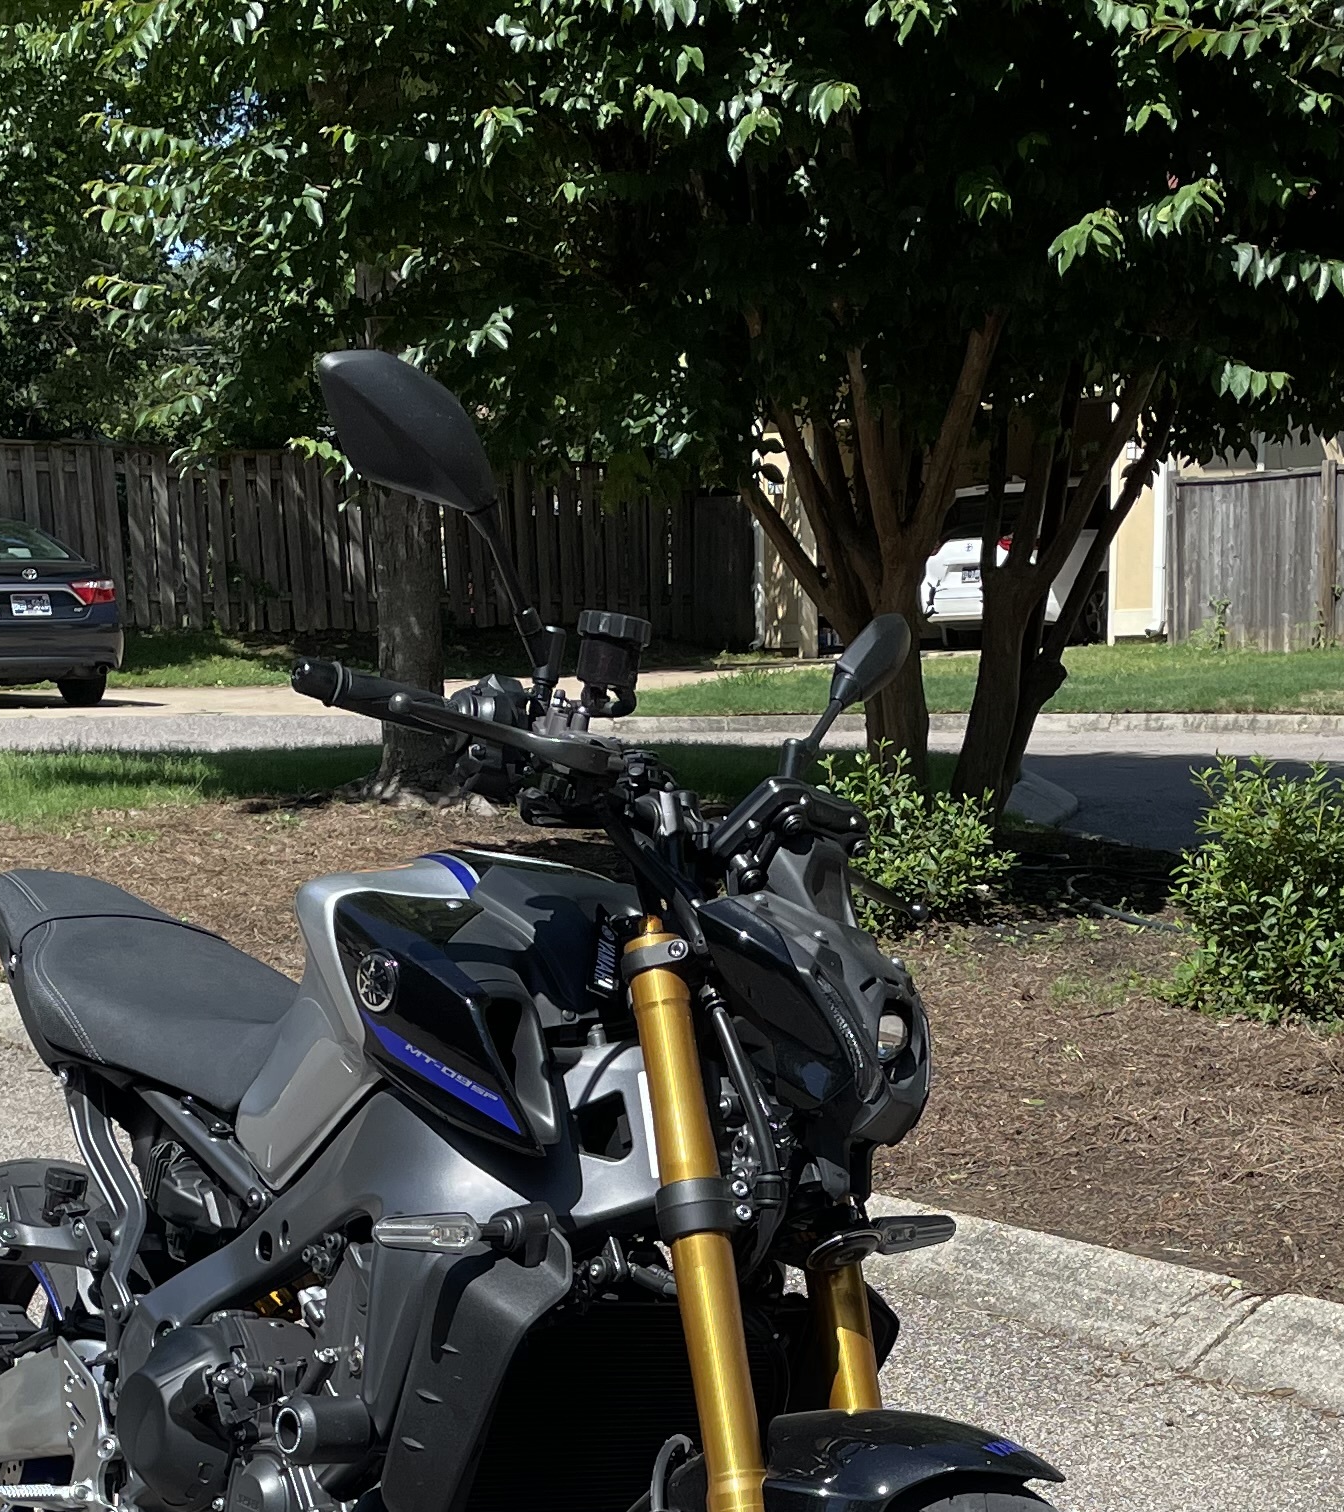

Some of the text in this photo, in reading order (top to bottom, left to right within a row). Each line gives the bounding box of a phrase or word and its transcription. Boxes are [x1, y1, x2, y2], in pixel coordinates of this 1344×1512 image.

[596, 938, 616, 989] YAMAHA
[405, 1043, 498, 1101] MT-09 SP
